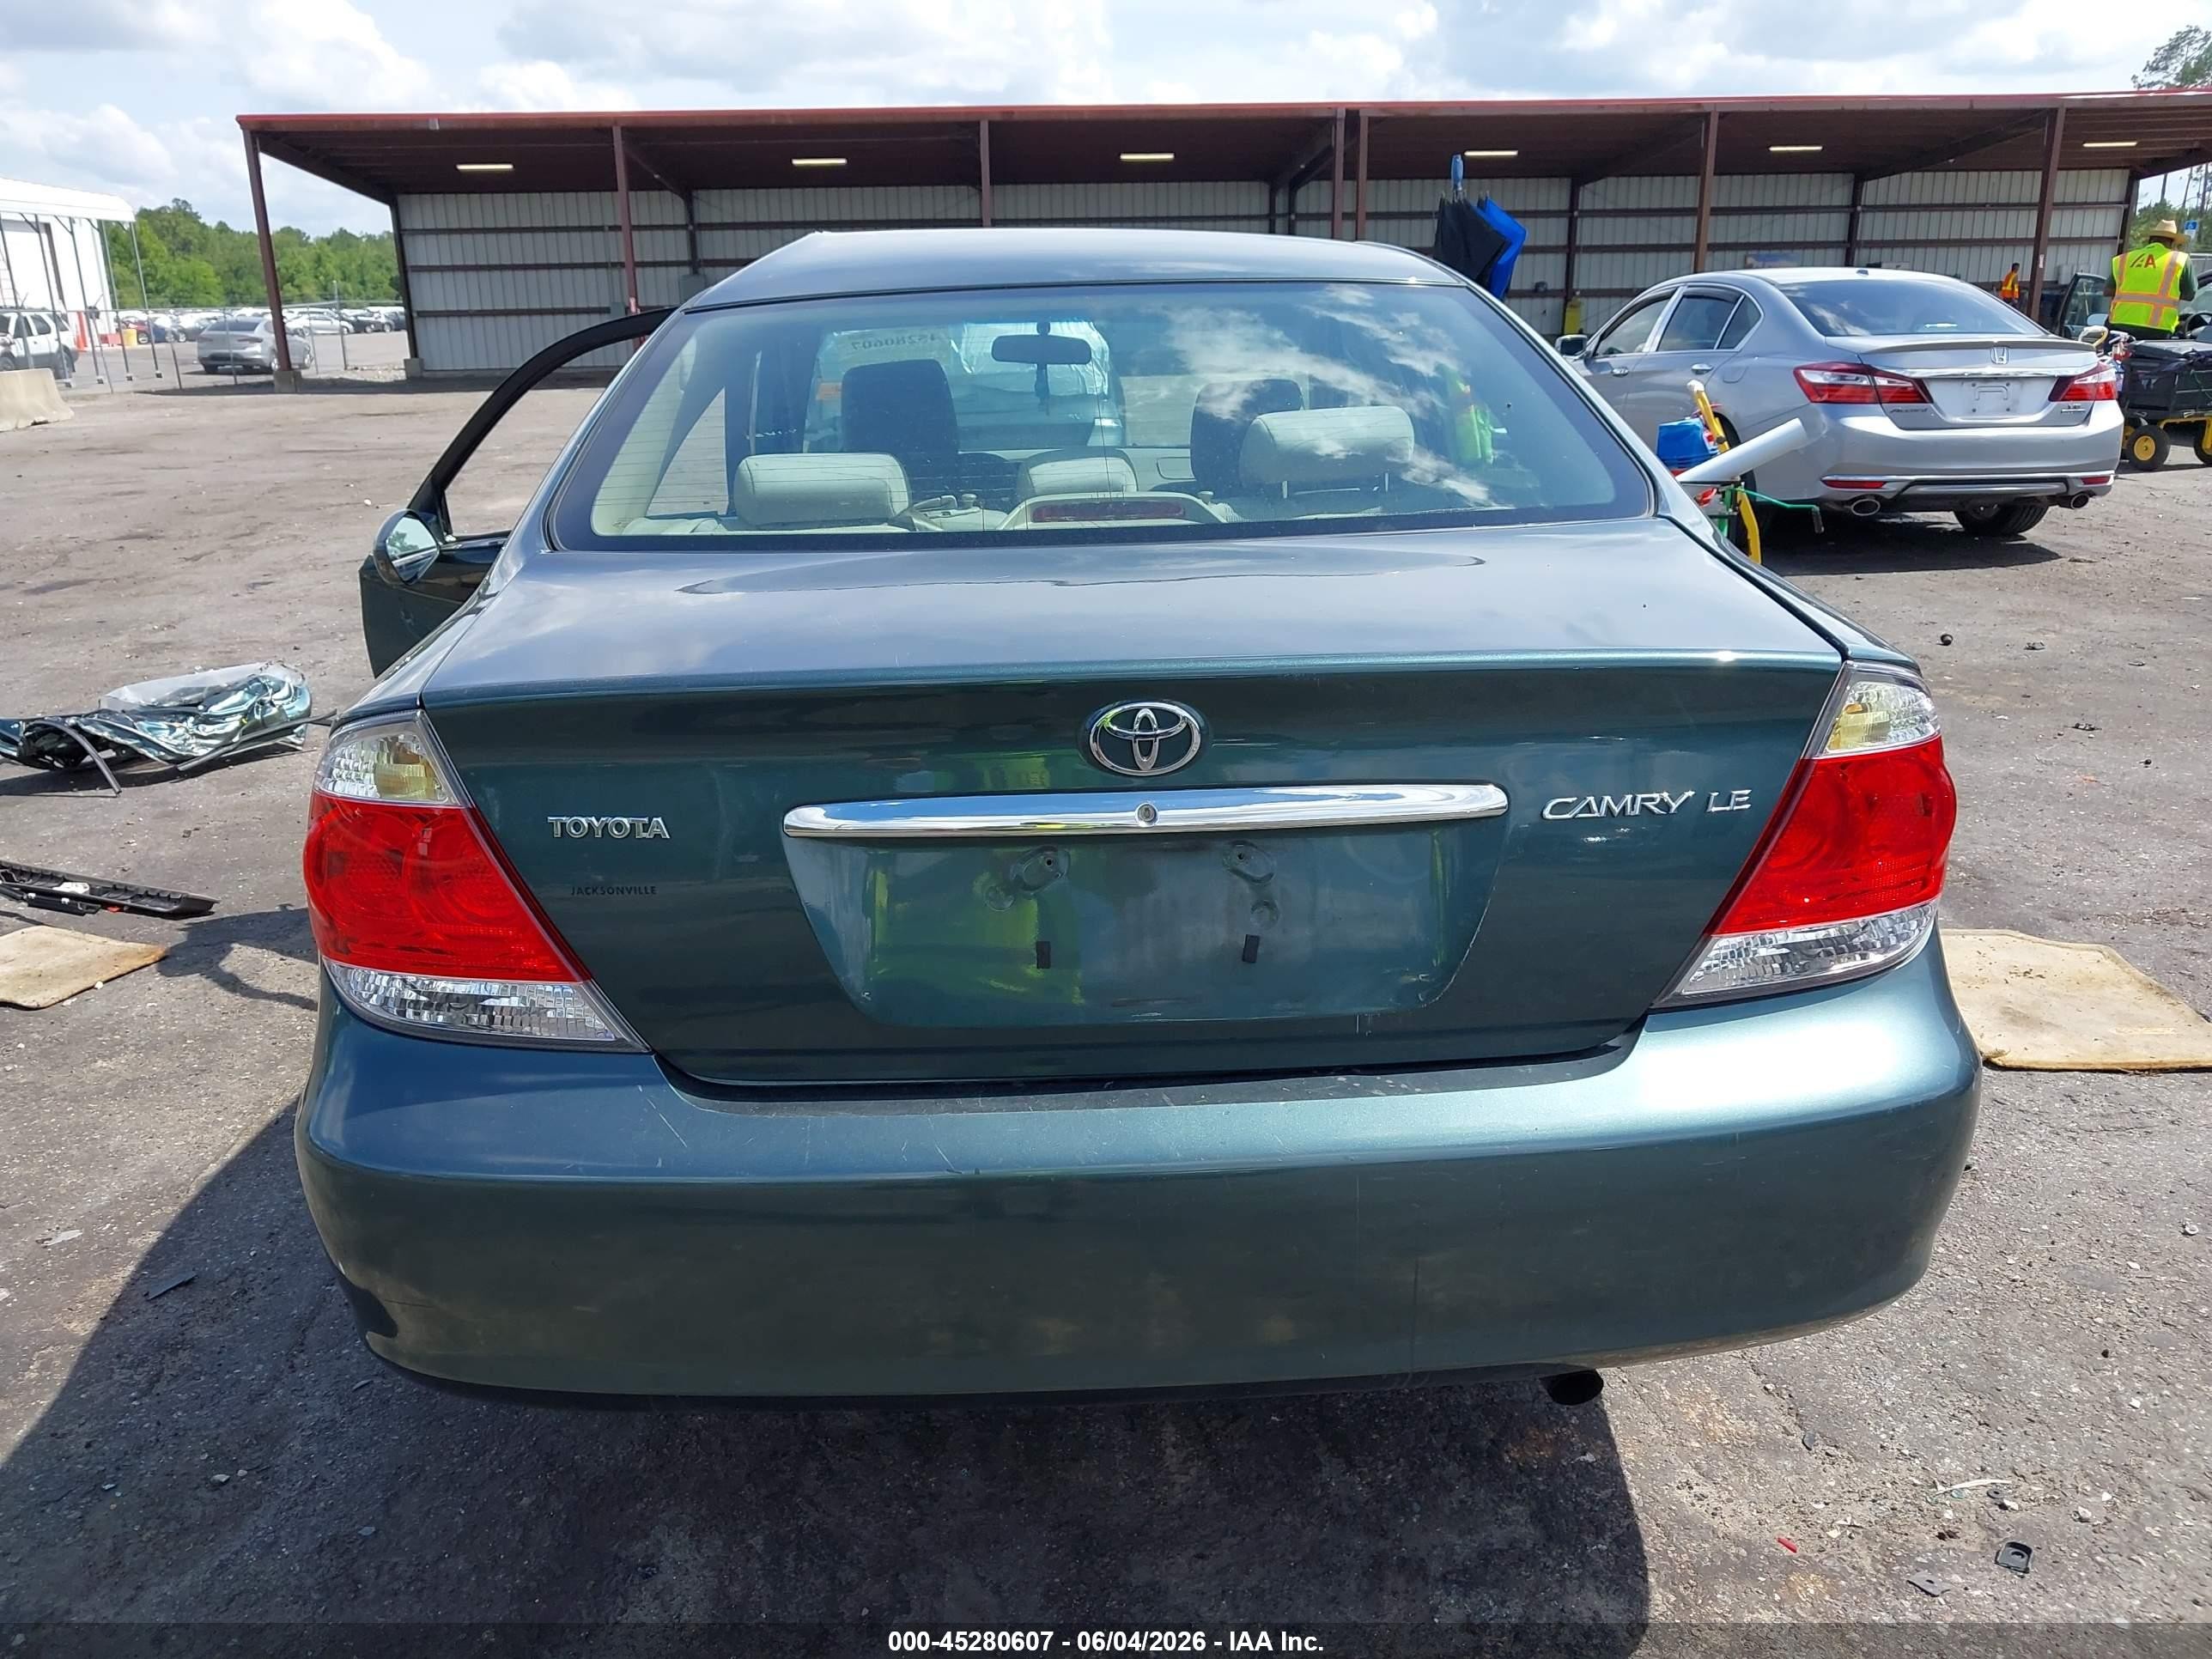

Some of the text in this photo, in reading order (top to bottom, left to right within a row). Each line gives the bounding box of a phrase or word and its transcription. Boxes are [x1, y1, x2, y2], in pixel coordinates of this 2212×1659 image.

[1542, 789, 1753, 819] CAMRY LE
[547, 817, 670, 839] TOYOTA
[571, 885, 657, 896] JACKSONVILLE
